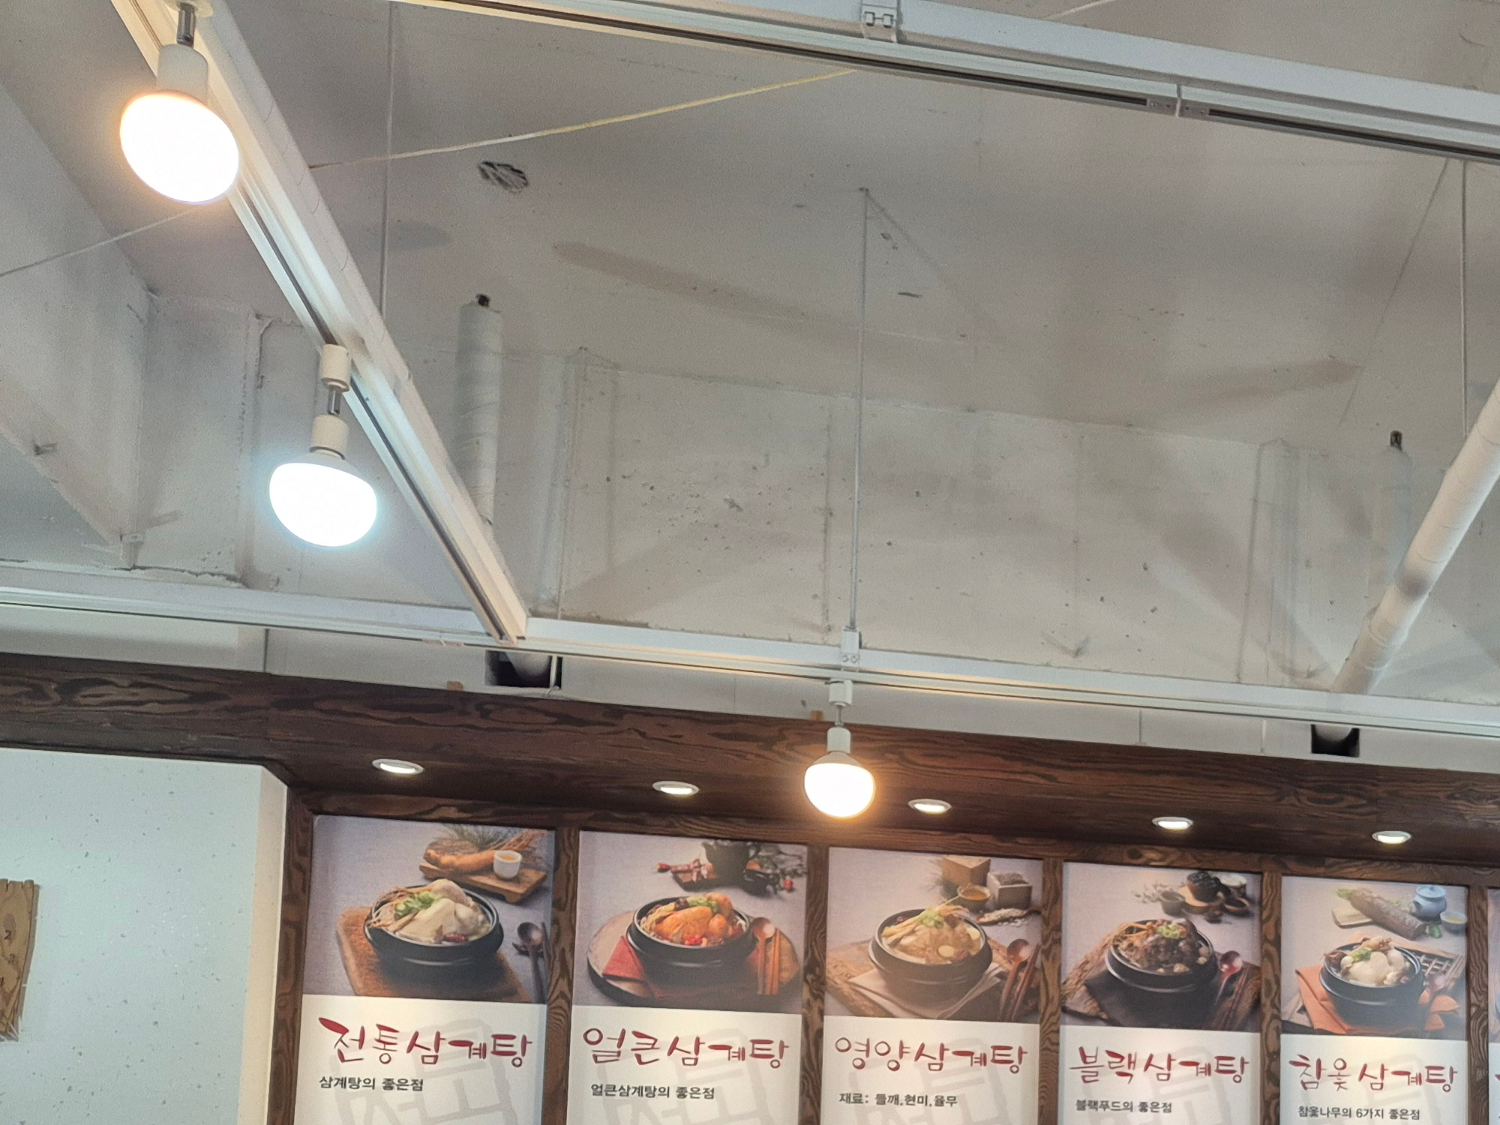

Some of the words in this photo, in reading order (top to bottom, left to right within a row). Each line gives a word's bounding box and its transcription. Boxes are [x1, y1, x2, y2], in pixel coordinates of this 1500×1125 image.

[318, 1017, 533, 1068] 전통삼계탕
[582, 1027, 790, 1069] 얼큰삼계탕
[835, 1037, 1029, 1074] 영양삼계탕
[1069, 1045, 1250, 1085] 블랙삼계탕
[1288, 1053, 1458, 1093] 참옻삼계탕
[319, 1076, 376, 1090] 삼계탕의
[381, 1078, 424, 1092] 좋은점
[590, 1084, 671, 1099] 얼큰삼계탕의
[675, 1087, 715, 1099] 좋은점
[1075, 1100, 1134, 1112] 블랙푸드의
[1137, 1101, 1173, 1113] 좋은점
[1298, 1106, 1353, 1118] 참옻나무의
[1355, 1108, 1385, 1119] 6가지
[1389, 1108, 1421, 1120] 좋은점
